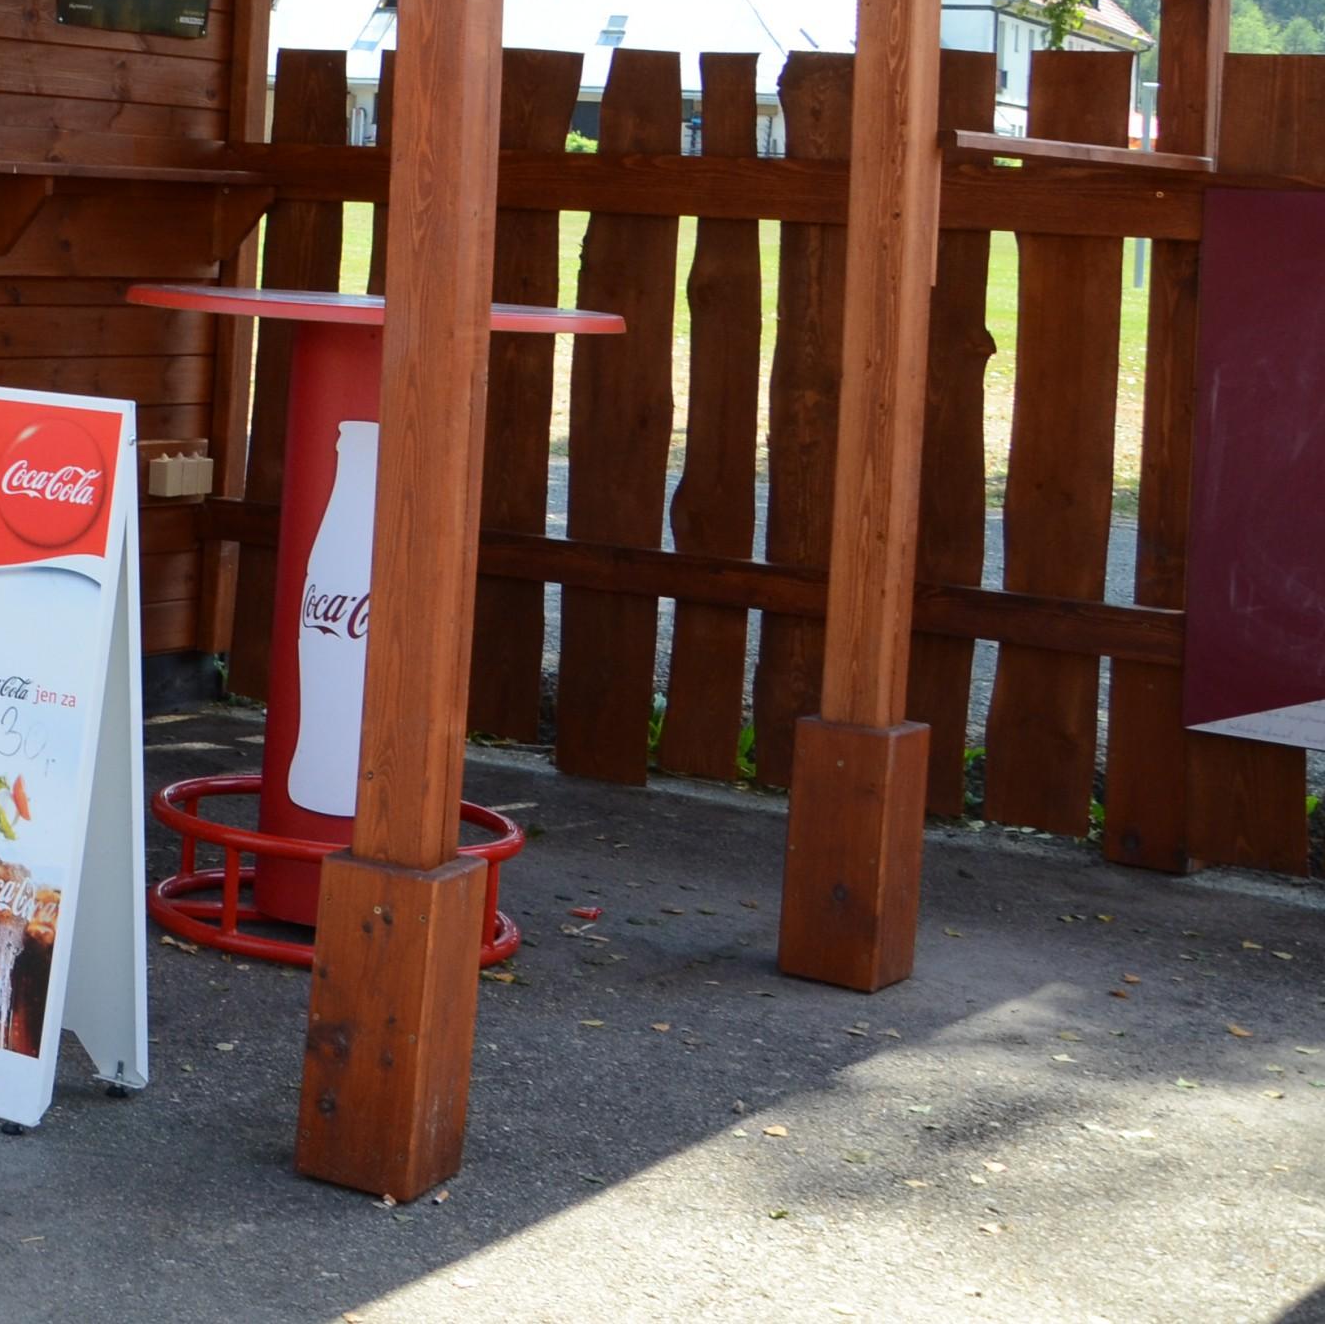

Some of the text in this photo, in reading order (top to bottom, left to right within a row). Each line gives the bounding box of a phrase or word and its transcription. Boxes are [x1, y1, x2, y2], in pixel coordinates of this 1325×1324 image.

[1, 459, 102, 505] Coca-Cola
[302, 584, 371, 640] Coca-C
[32, 685, 57, 705] jen
[61, 693, 77, 708] za
